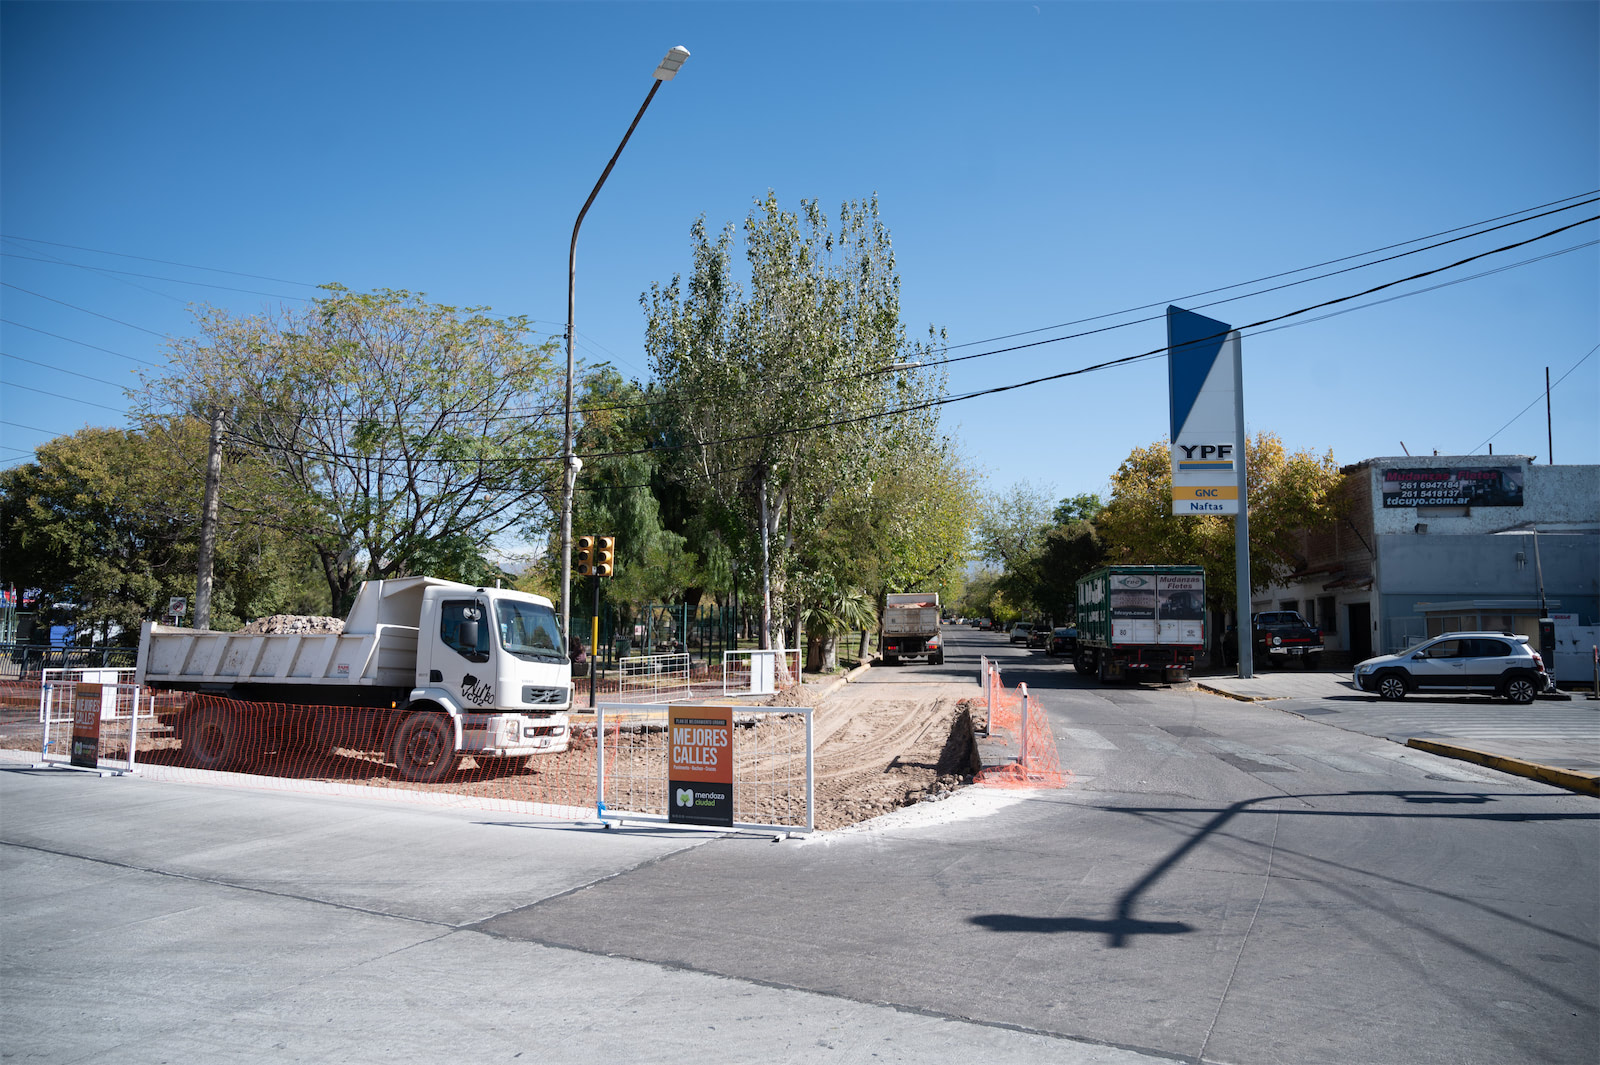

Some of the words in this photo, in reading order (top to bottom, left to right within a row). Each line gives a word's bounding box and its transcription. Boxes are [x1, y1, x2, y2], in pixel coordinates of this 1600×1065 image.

[1180, 445, 1233, 458] YPF
[1386, 472, 1450, 480] Mudanzas
[1458, 470, 1497, 480] Fletes
[1195, 488, 1218, 497] GNC
[1190, 502, 1223, 510] Naftas
[1386, 496, 1470, 506] tdcuyo.com.ar
[674, 728, 728, 747] MEJORES
[673, 746, 718, 765] CALLES
[695, 792, 725, 800] mendoza
